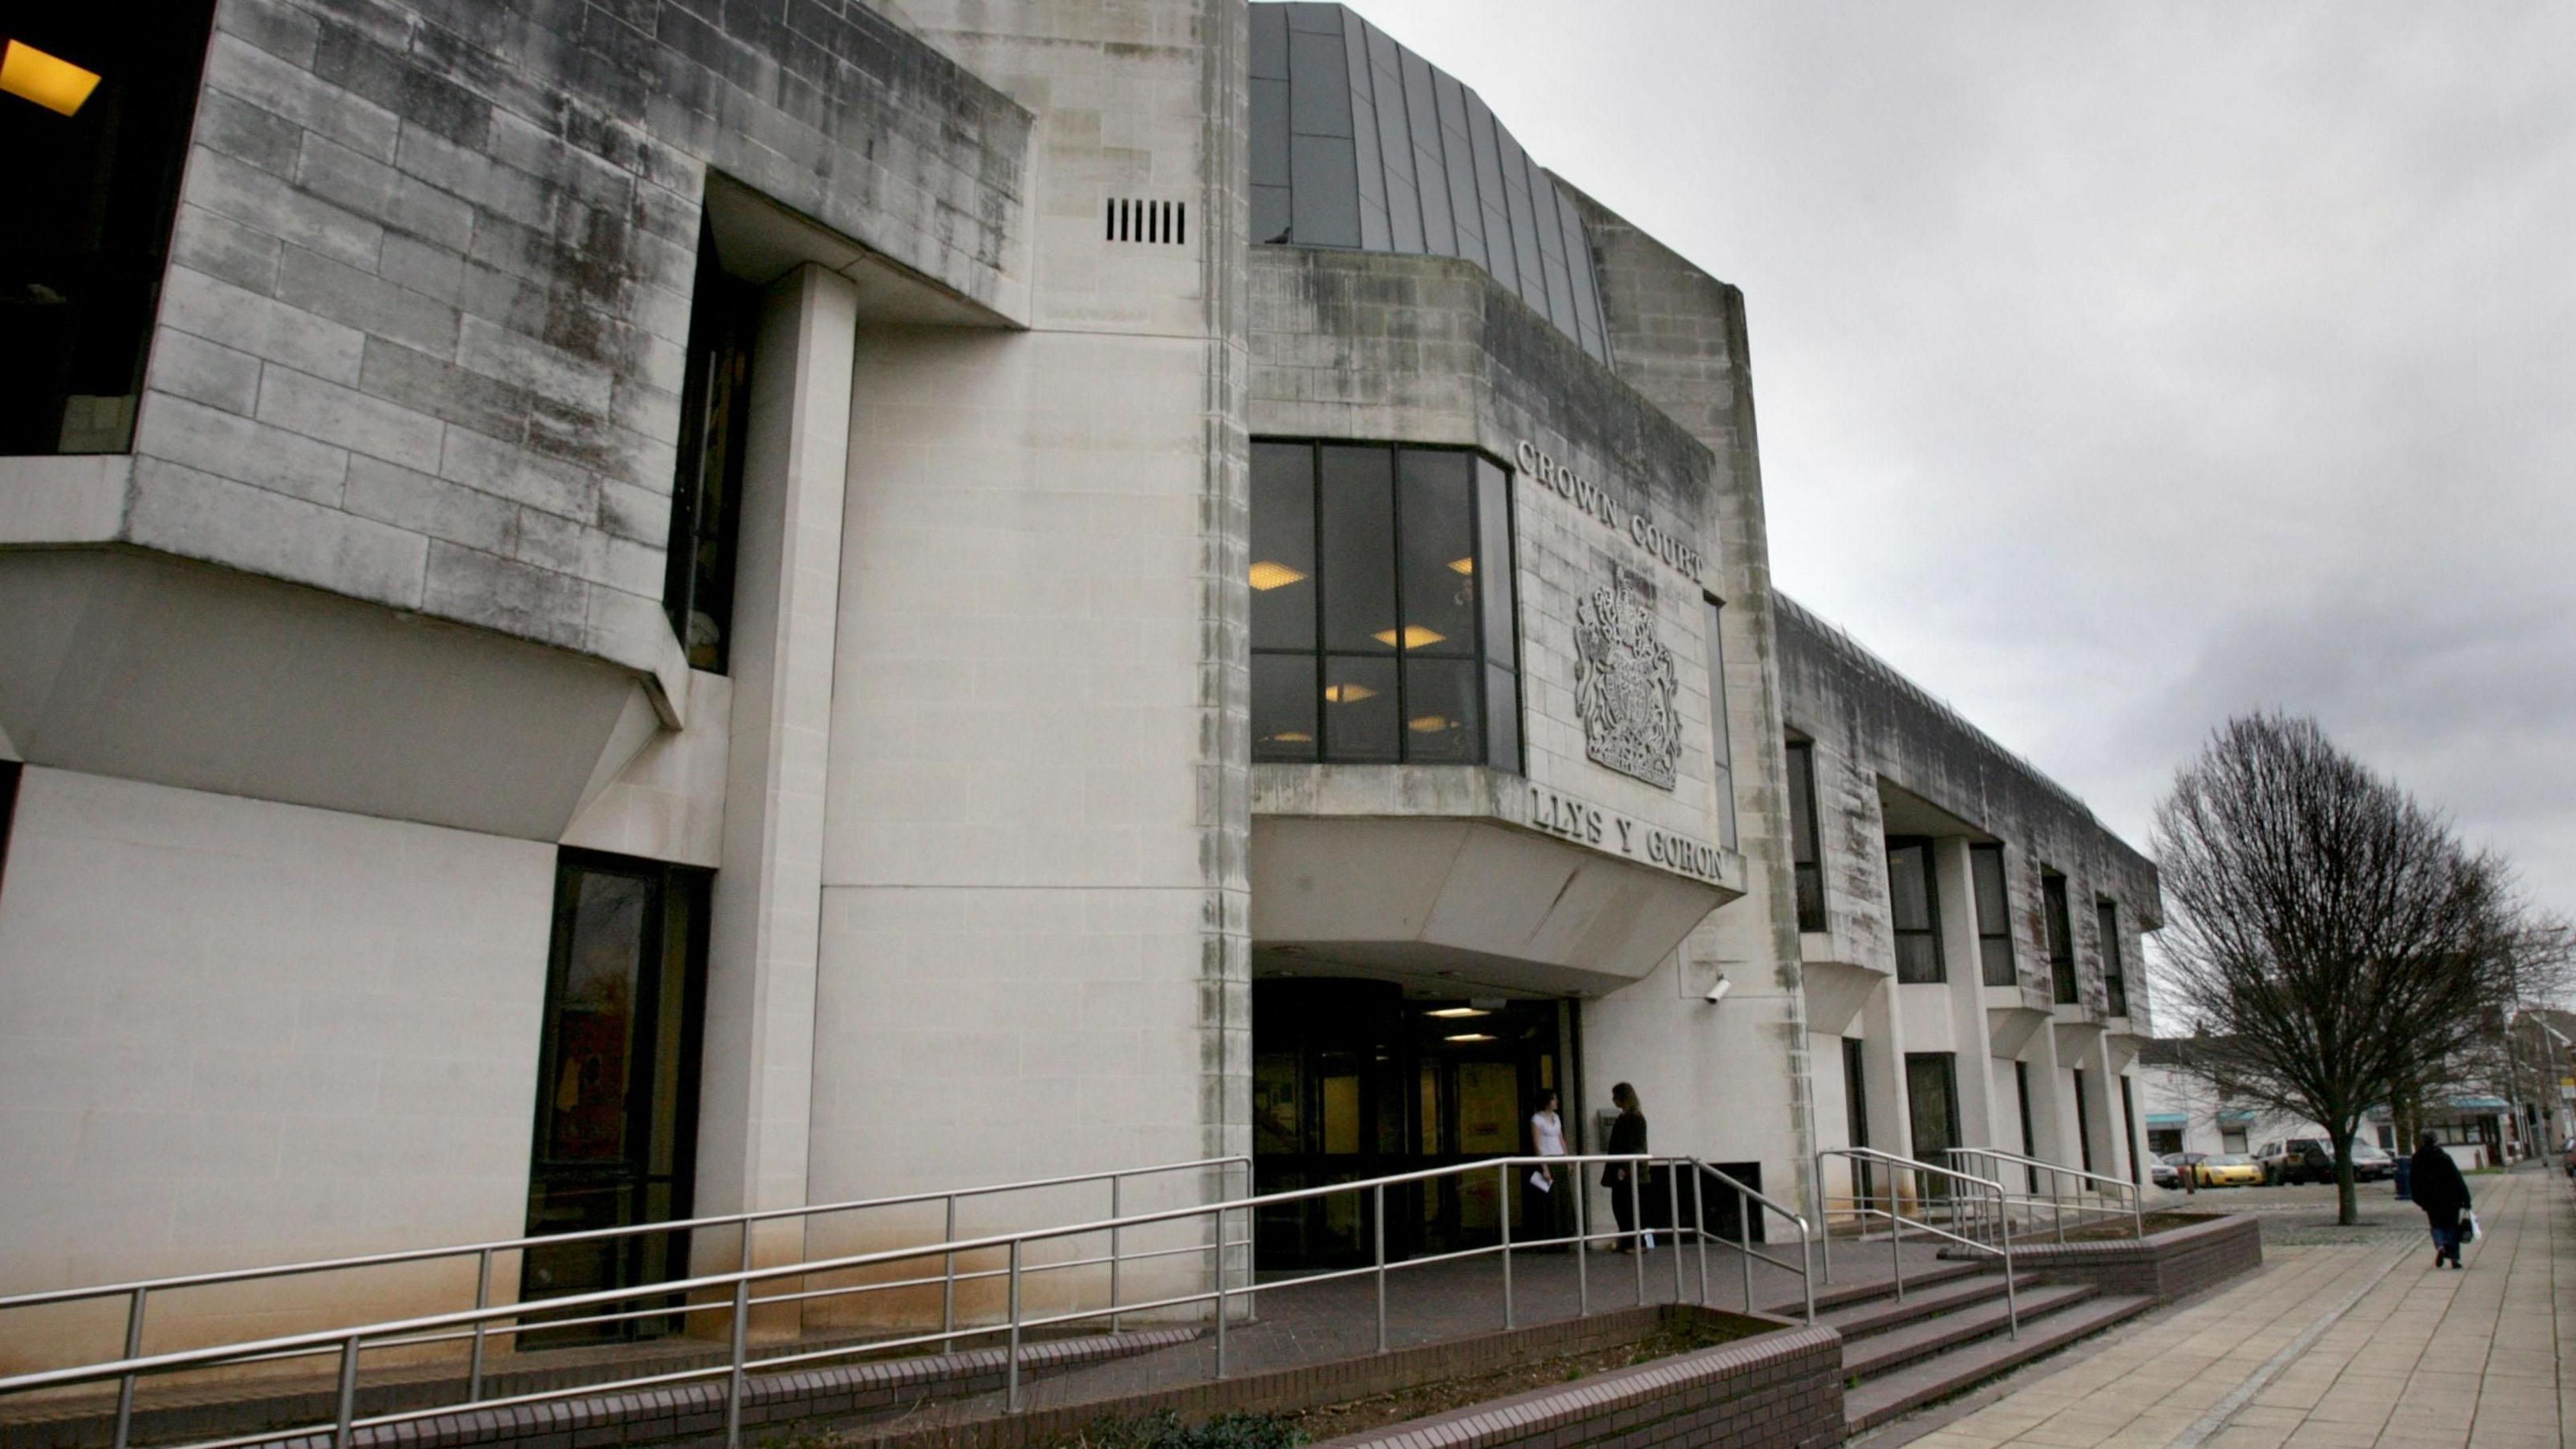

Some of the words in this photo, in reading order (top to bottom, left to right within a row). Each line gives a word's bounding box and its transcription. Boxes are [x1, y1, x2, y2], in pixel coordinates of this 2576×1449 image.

[1515, 439, 1618, 529] CROWN
[1631, 515, 1703, 584] COURT
[1530, 788, 1603, 844] LLYS
[1616, 818, 1633, 853] Y
[1647, 830, 1723, 880] GORON
